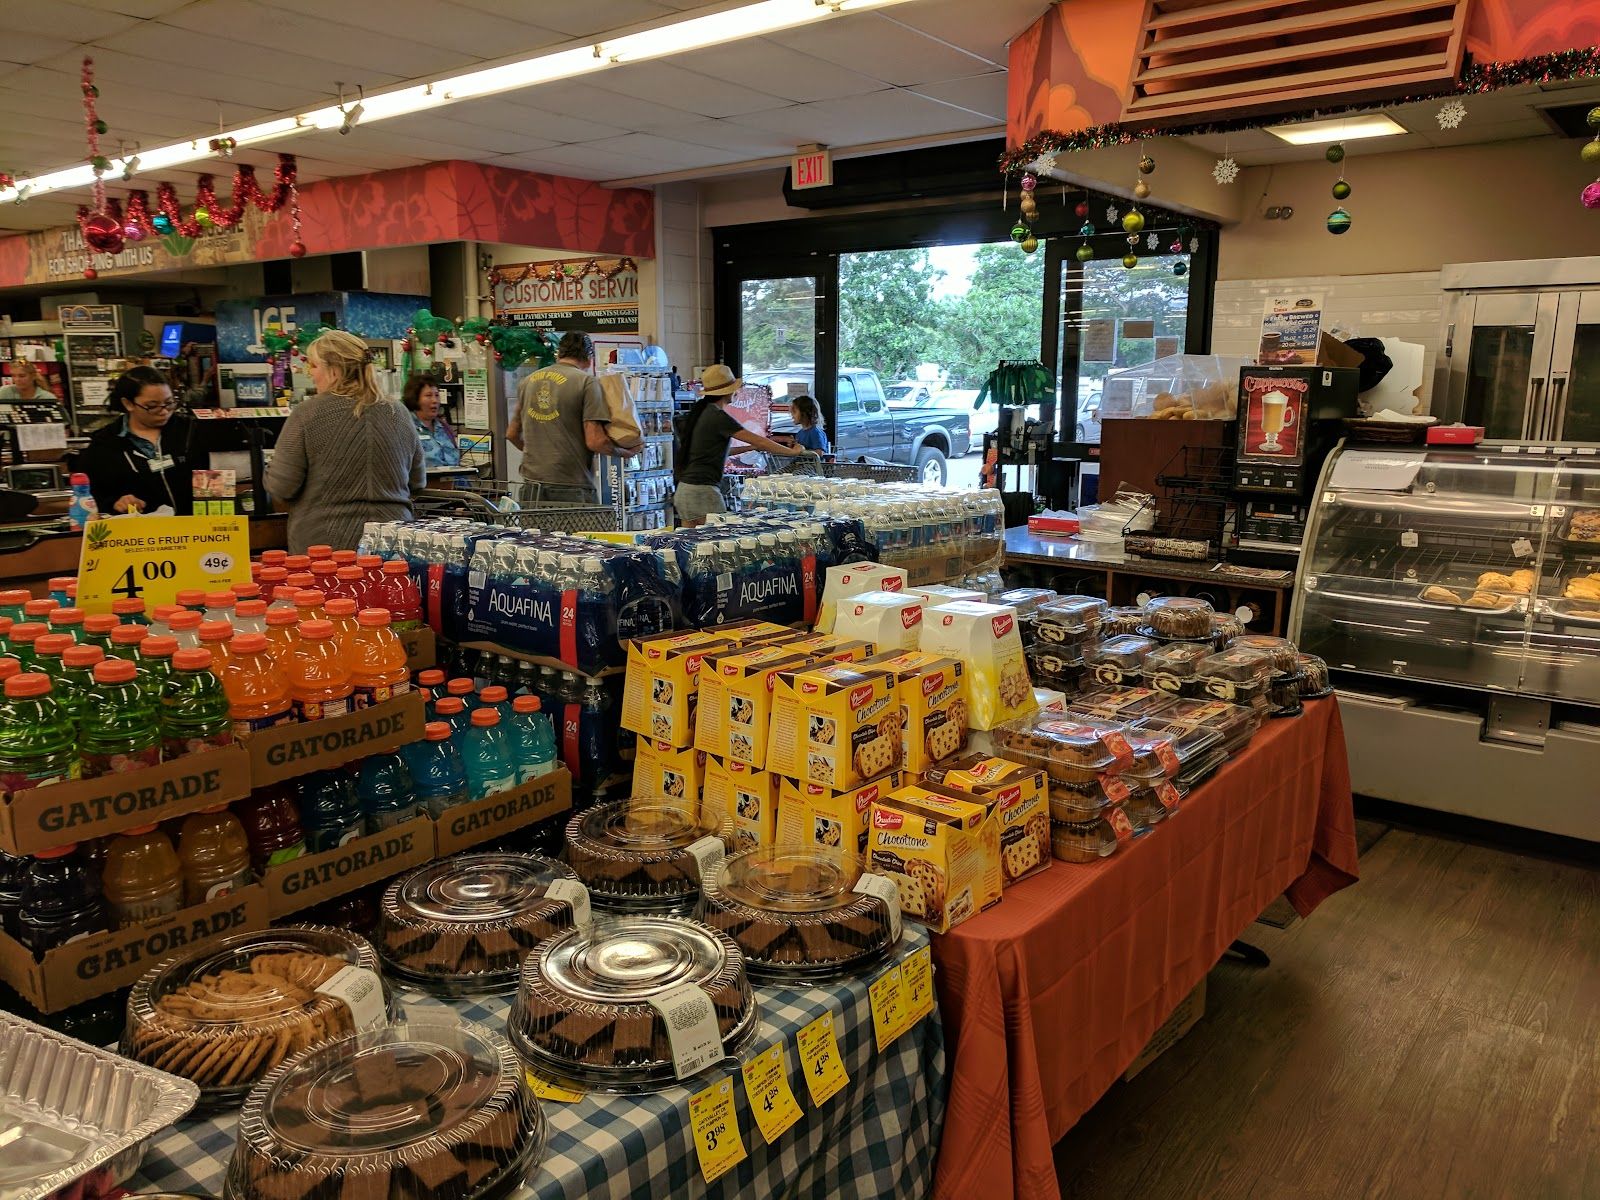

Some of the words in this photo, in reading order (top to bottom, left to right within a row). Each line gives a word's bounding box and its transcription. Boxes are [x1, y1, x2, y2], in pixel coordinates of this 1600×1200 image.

[797, 155, 825, 185] EXIT
[48, 258, 65, 276] FOR
[115, 248, 138, 267] WITH
[140, 246, 153, 265] US
[503, 281, 584, 304] CUSTOMER
[246, 306, 296, 354] ICE
[147, 537, 156, 545] G
[159, 536, 189, 545] FRUIT
[204, 557, 229, 570] 49¢
[803, 571, 814, 582] 24
[430, 580, 440, 590] 24
[739, 573, 798, 607] AQUAFINA
[488, 588, 554, 627] AQUAFINA
[562, 607, 574, 619] 24
[266, 711, 406, 766] GATORADE
[566, 720, 577, 733] 24
[38, 769, 221, 832] GATORADE
[451, 784, 555, 836] GATORADE
[875, 809, 902, 828] Bauducco
[282, 831, 416, 895] GATORADE
[76, 902, 248, 980] GATORADE
[705, 1122, 726, 1151] 398
